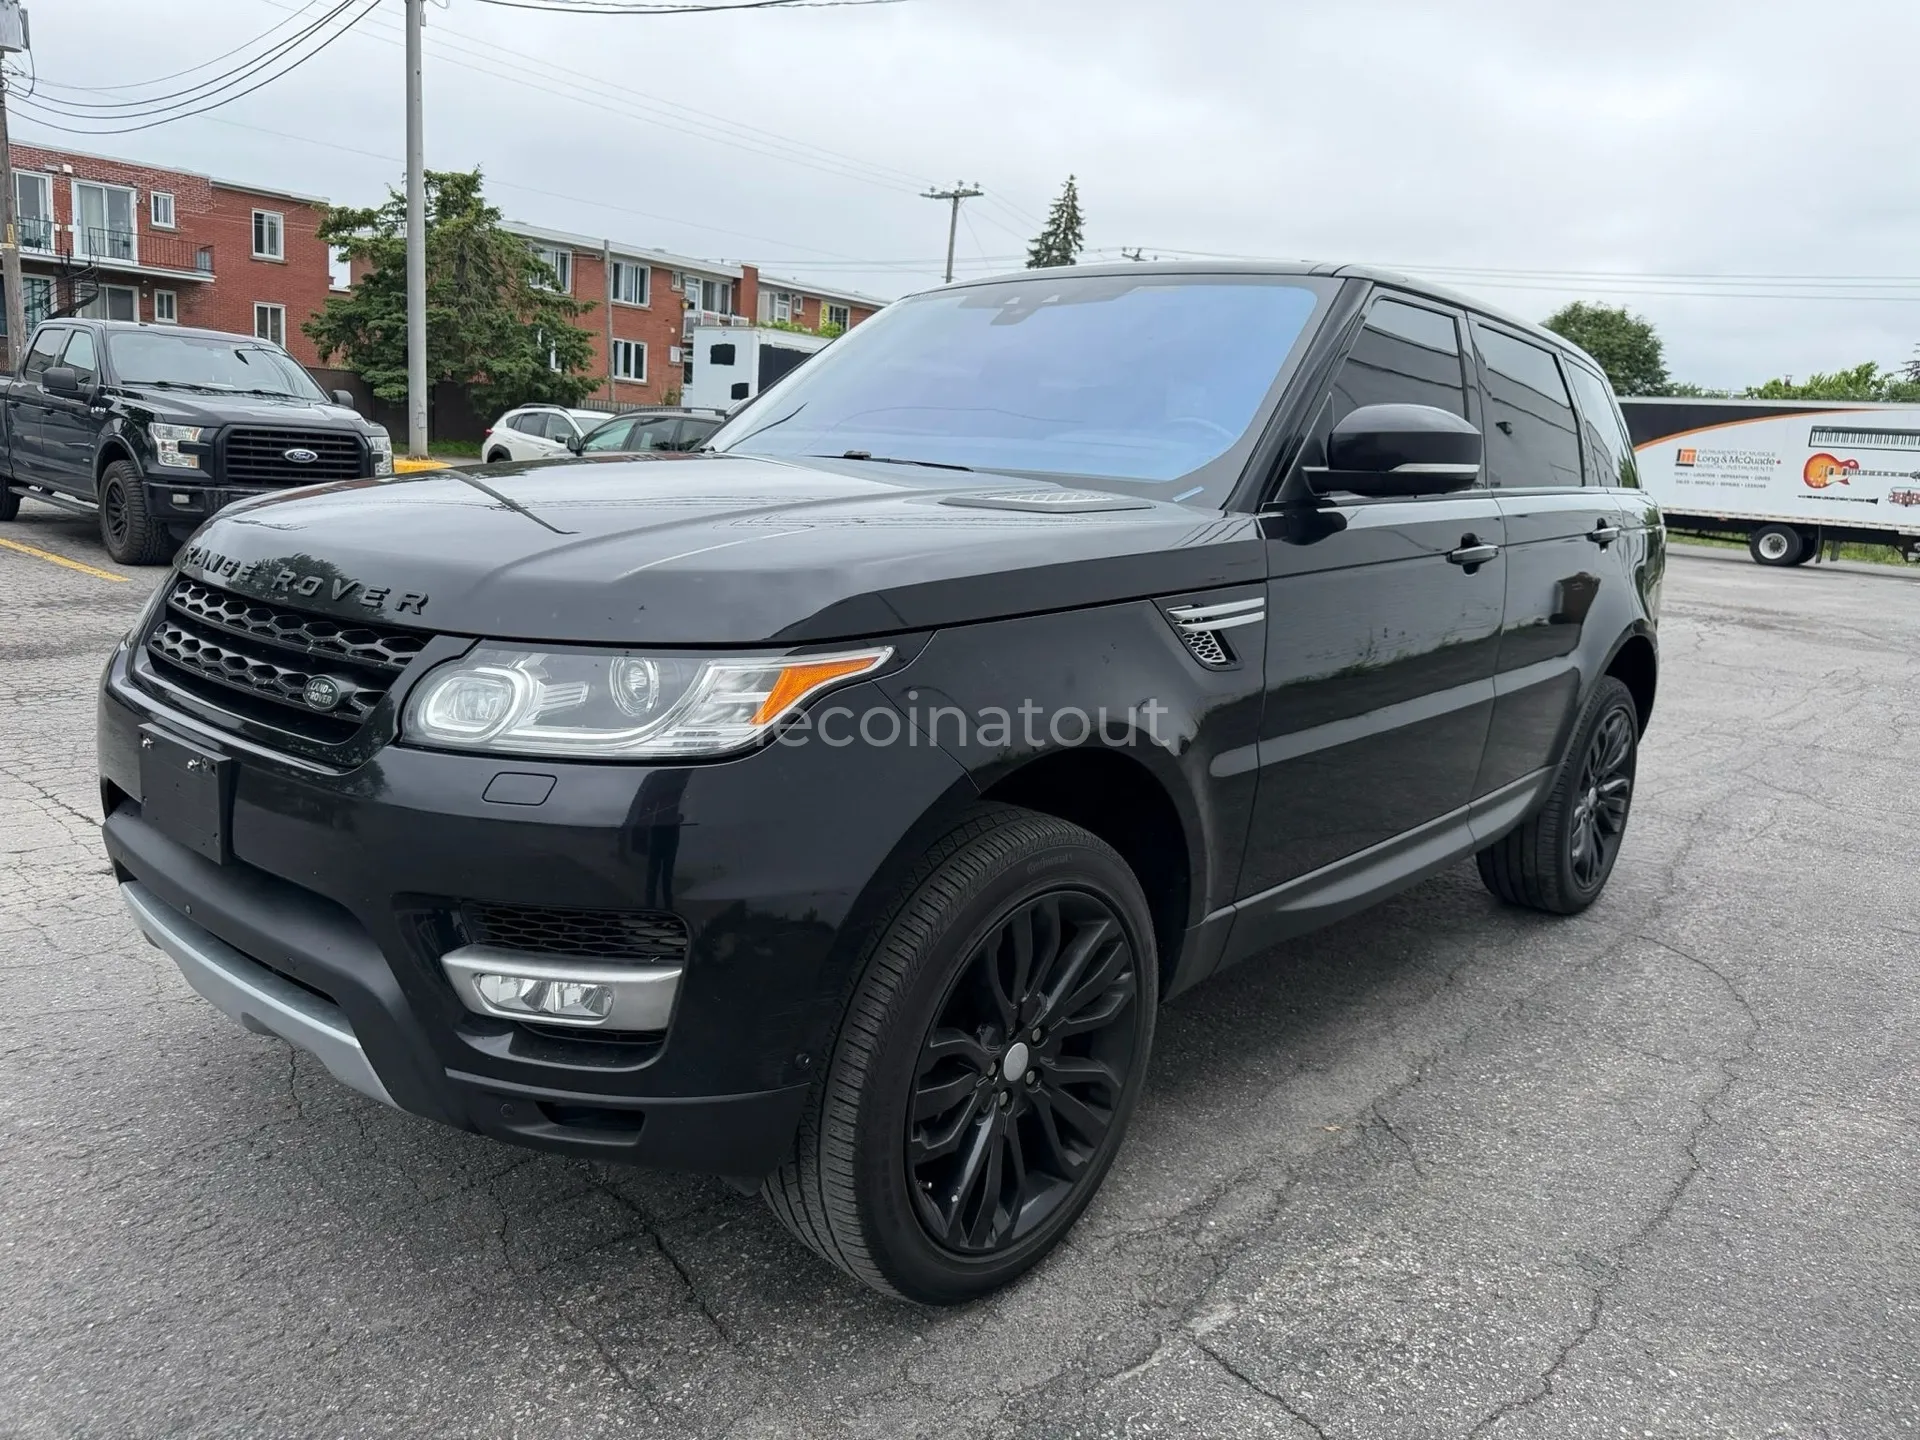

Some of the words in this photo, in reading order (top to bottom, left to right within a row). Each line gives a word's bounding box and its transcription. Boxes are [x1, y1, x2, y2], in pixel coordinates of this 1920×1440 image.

[1697, 454, 1720, 465] Long
[1720, 456, 1728, 464] &
[1729, 455, 1775, 466] McQuade
[181, 546, 259, 582] RANGE
[271, 570, 430, 615] ROVER
[310, 681, 329, 693] LAND
[309, 691, 332, 705] ROVER
